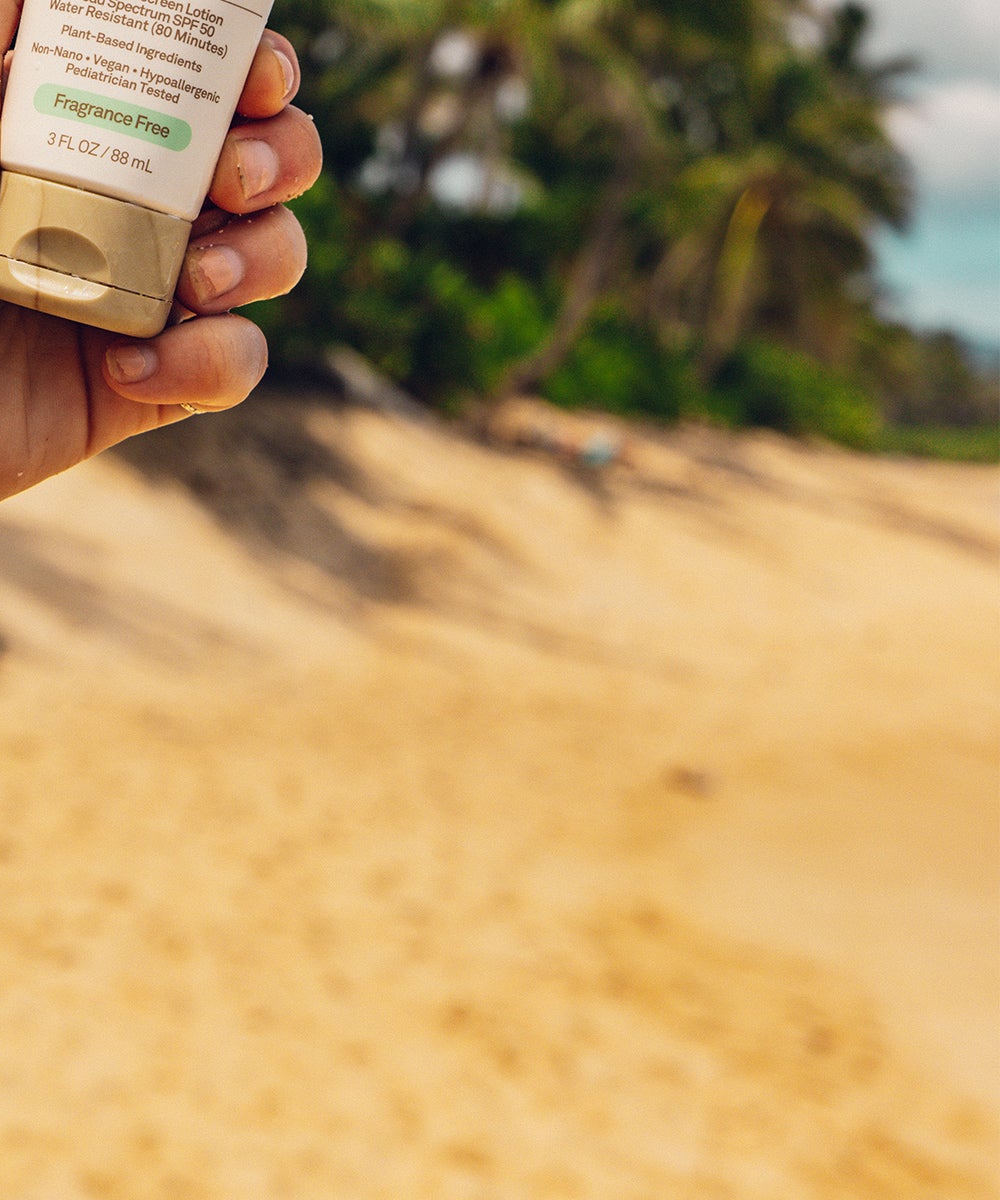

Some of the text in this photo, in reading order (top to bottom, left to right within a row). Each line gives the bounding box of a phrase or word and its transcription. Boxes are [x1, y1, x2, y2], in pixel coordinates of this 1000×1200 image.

[85, 8, 149, 31] Resistant
[151, 24, 172, 38] (80
[175, 30, 229, 59] Minutes)
[172, 15, 199, 31] SPF
[200, 23, 215, 37] 50
[186, 3, 223, 26] Lotion
[61, 25, 202, 72] Plant-Based Ingredients
[31, 42, 221, 104] Non-Nano Vegan Hypoallergenic
[65, 63, 180, 104] Pediatrician Tested
[54, 93, 170, 138] Fragrance Free
[47, 132, 56, 145] 3
[58, 135, 75, 150] FL
[78, 140, 100, 157] OZ
[111, 149, 130, 165] 88
[131, 158, 153, 173] mL
